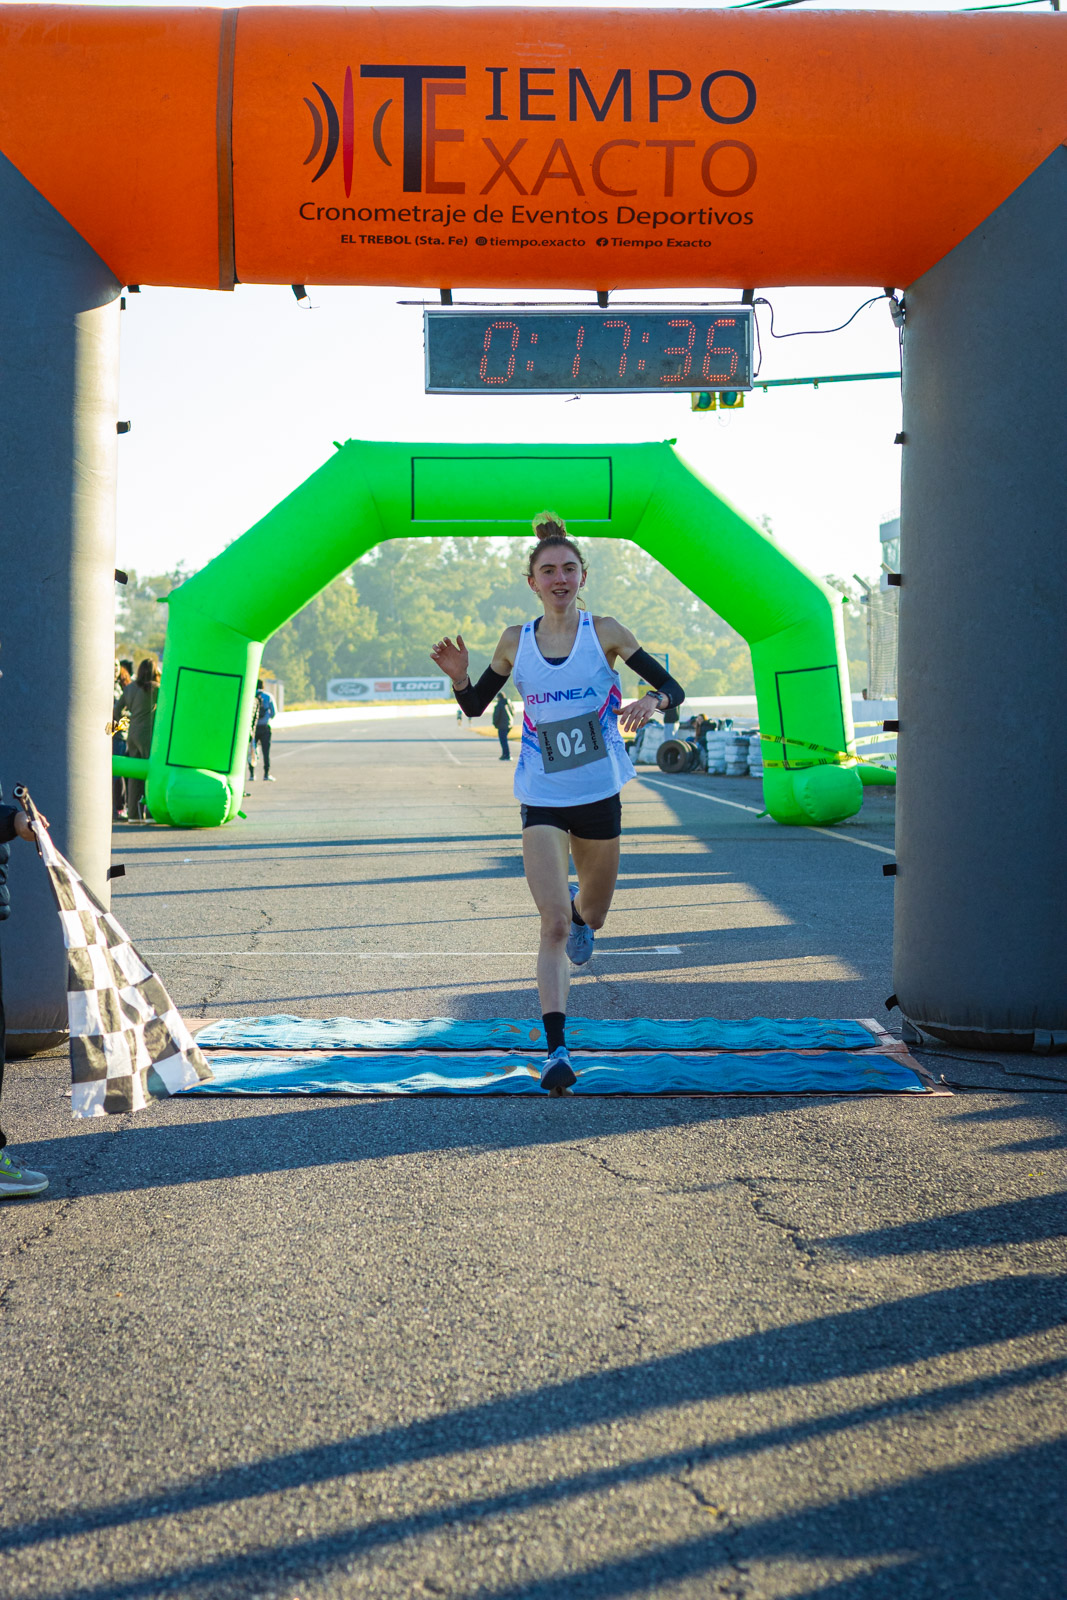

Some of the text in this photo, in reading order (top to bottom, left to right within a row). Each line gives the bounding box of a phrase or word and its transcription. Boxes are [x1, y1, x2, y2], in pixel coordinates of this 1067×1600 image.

[299, 202, 754, 229] Cronometraje de Eventos Deportivos
[340, 234, 356, 244] EL
[358, 235, 412, 245] TREBOL
[414, 236, 445, 247] (Sta.
[449, 236, 468, 247] Fe)
[610, 238, 664, 249] Tiempo
[666, 238, 712, 248] Exacto
[395, 681, 441, 691] LONG
[526, 687, 597, 705] RUNNEA
[556, 728, 587, 758] 02
